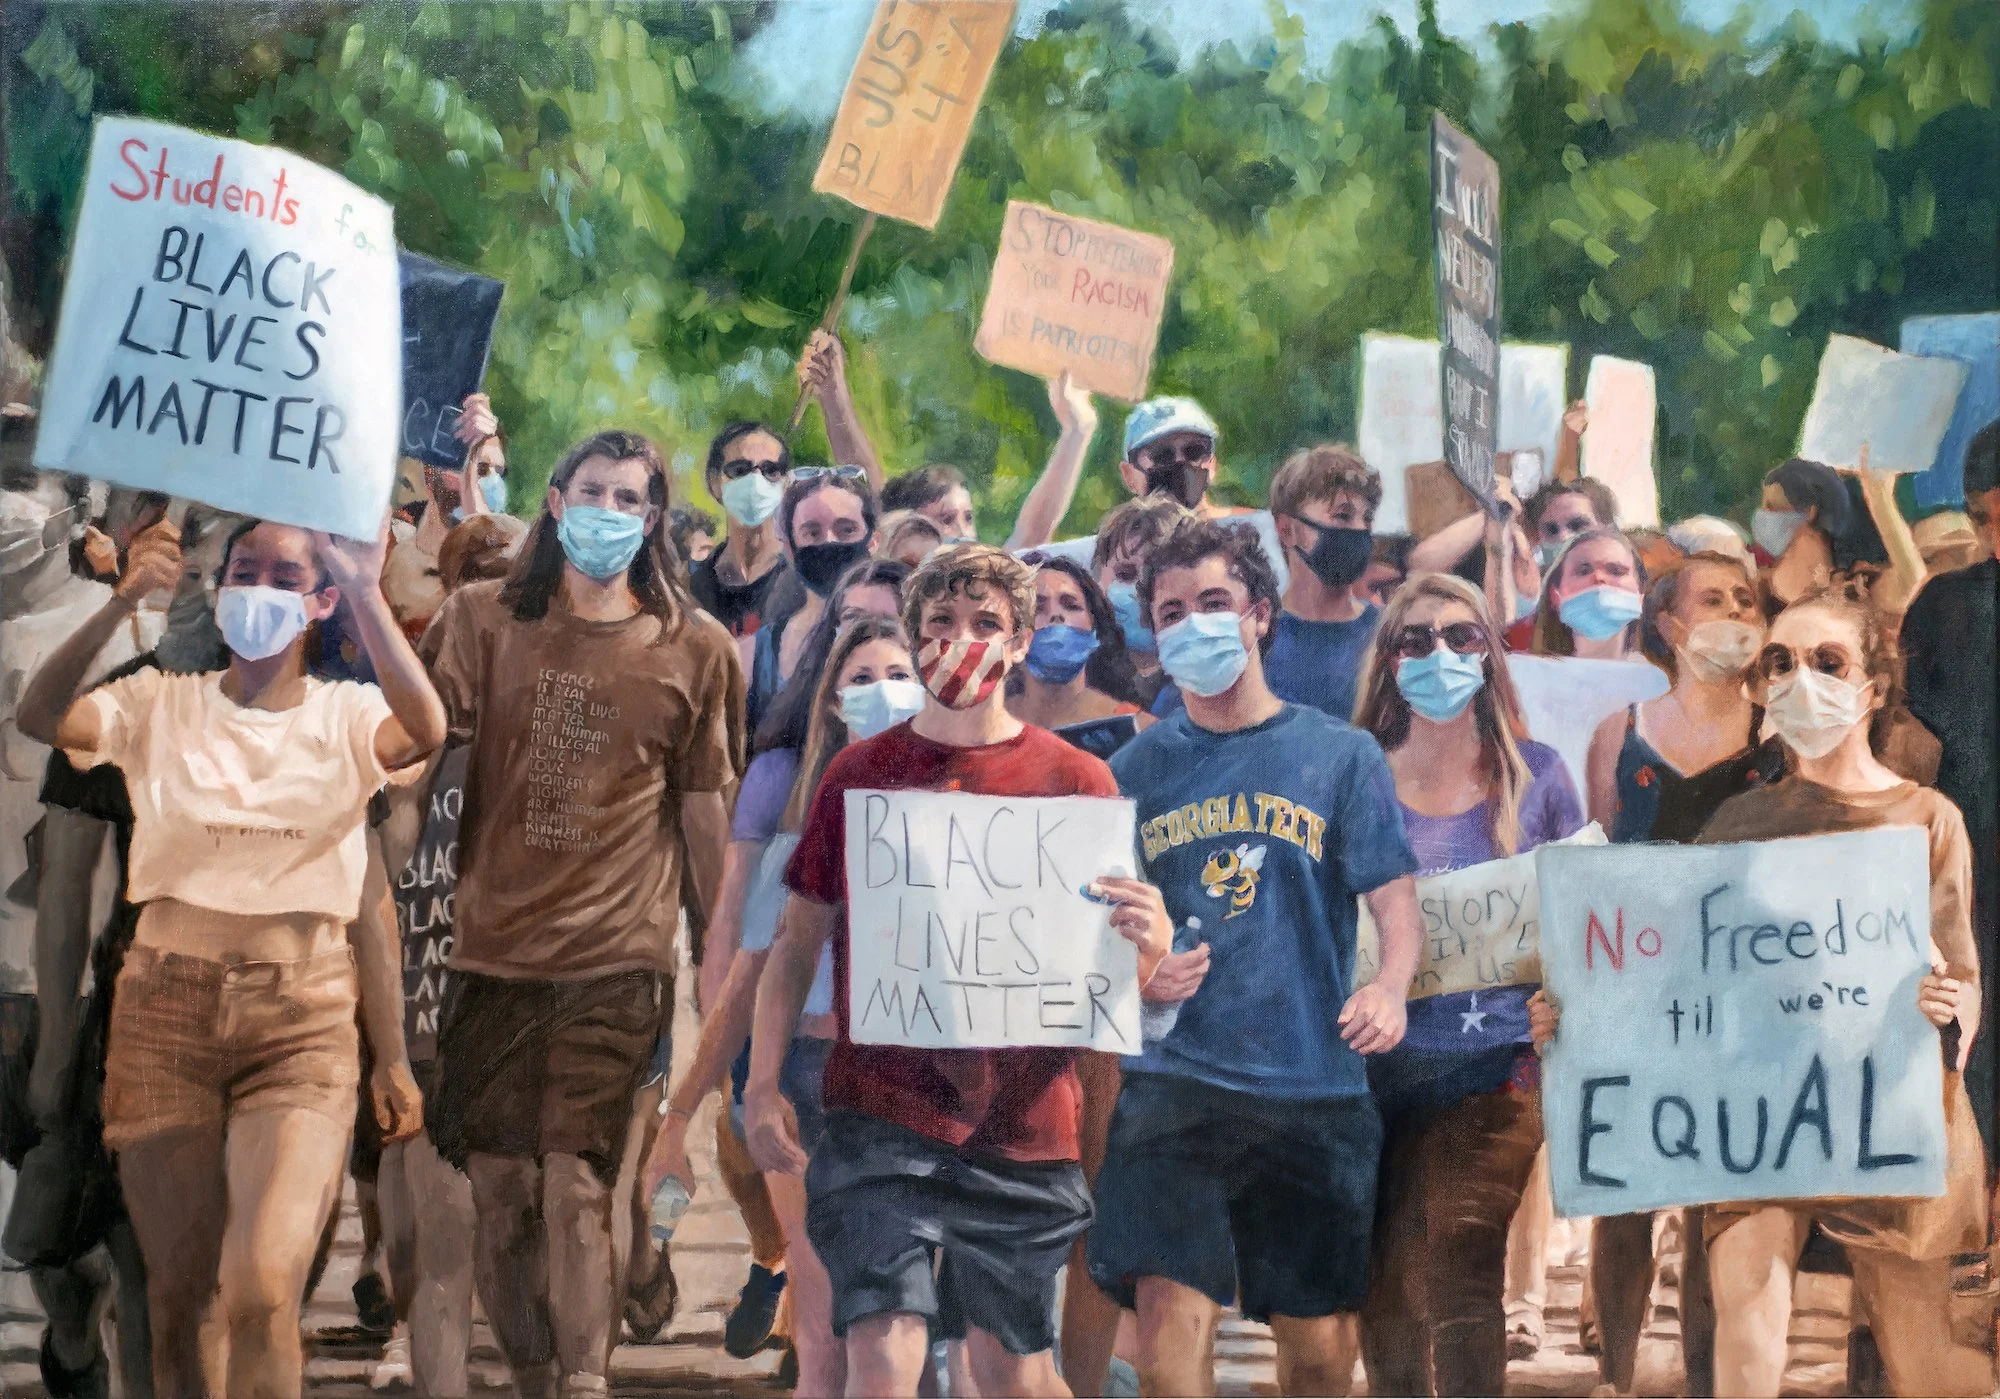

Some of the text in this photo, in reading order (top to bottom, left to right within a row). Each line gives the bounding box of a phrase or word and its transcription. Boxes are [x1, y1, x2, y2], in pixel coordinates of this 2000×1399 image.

[110, 138, 301, 226] Students
[153, 225, 337, 316] BLACK
[1071, 267, 1149, 318] RACISM
[118, 286, 327, 382] LIVES
[92, 375, 347, 475] MATTER
[537, 693, 583, 713] BLACK
[525, 821, 583, 841] KINDNESS
[865, 793, 1073, 899] BLACK
[1140, 791, 1327, 863] GEORGIA TECH
[398, 841, 458, 889] BLAC
[396, 893, 456, 933] BLAC
[894, 896, 1040, 976] LIVES
[1585, 905, 1663, 973] No
[861, 972, 1127, 1046] MATTER
[1667, 981, 1871, 1045] til we're
[1578, 1050, 1920, 1189] EQUAL
